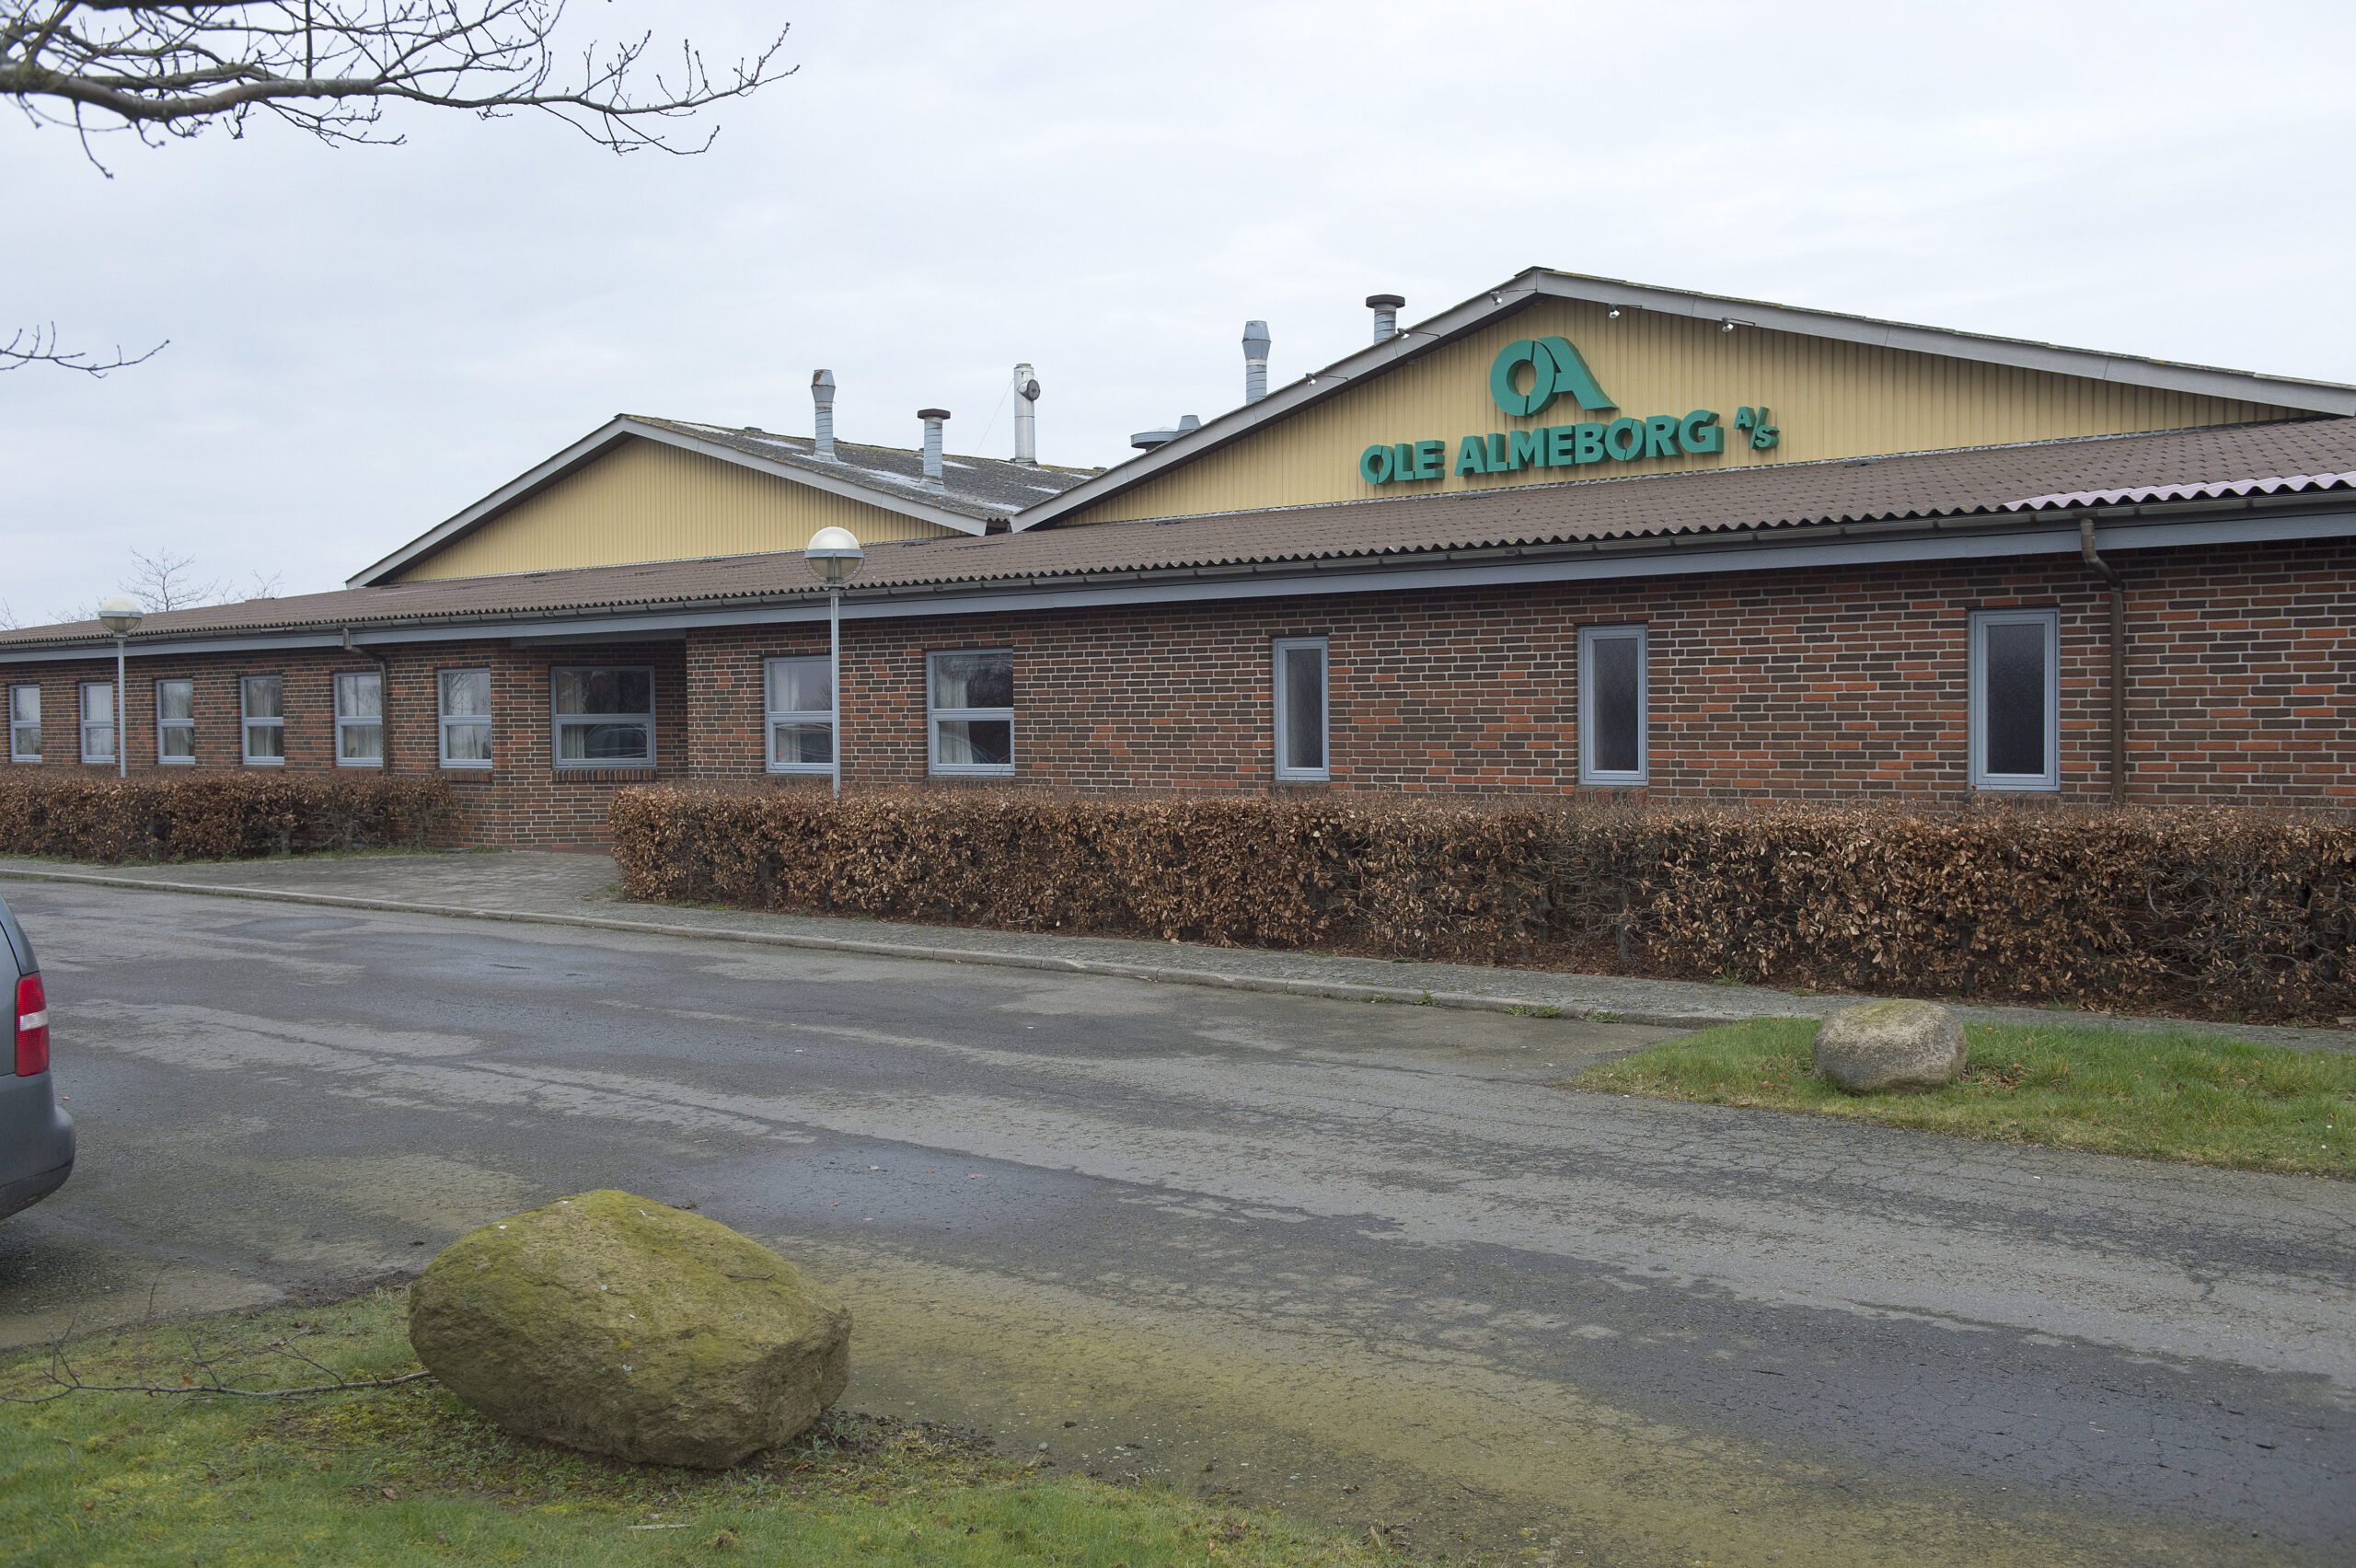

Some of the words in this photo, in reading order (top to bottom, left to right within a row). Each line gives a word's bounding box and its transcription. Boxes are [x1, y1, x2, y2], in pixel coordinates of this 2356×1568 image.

[1490, 336, 1618, 417] OA
[1359, 440, 1445, 485] OLE
[1454, 409, 1724, 477] ALMEBORG
[1733, 406, 1780, 449] A/S
